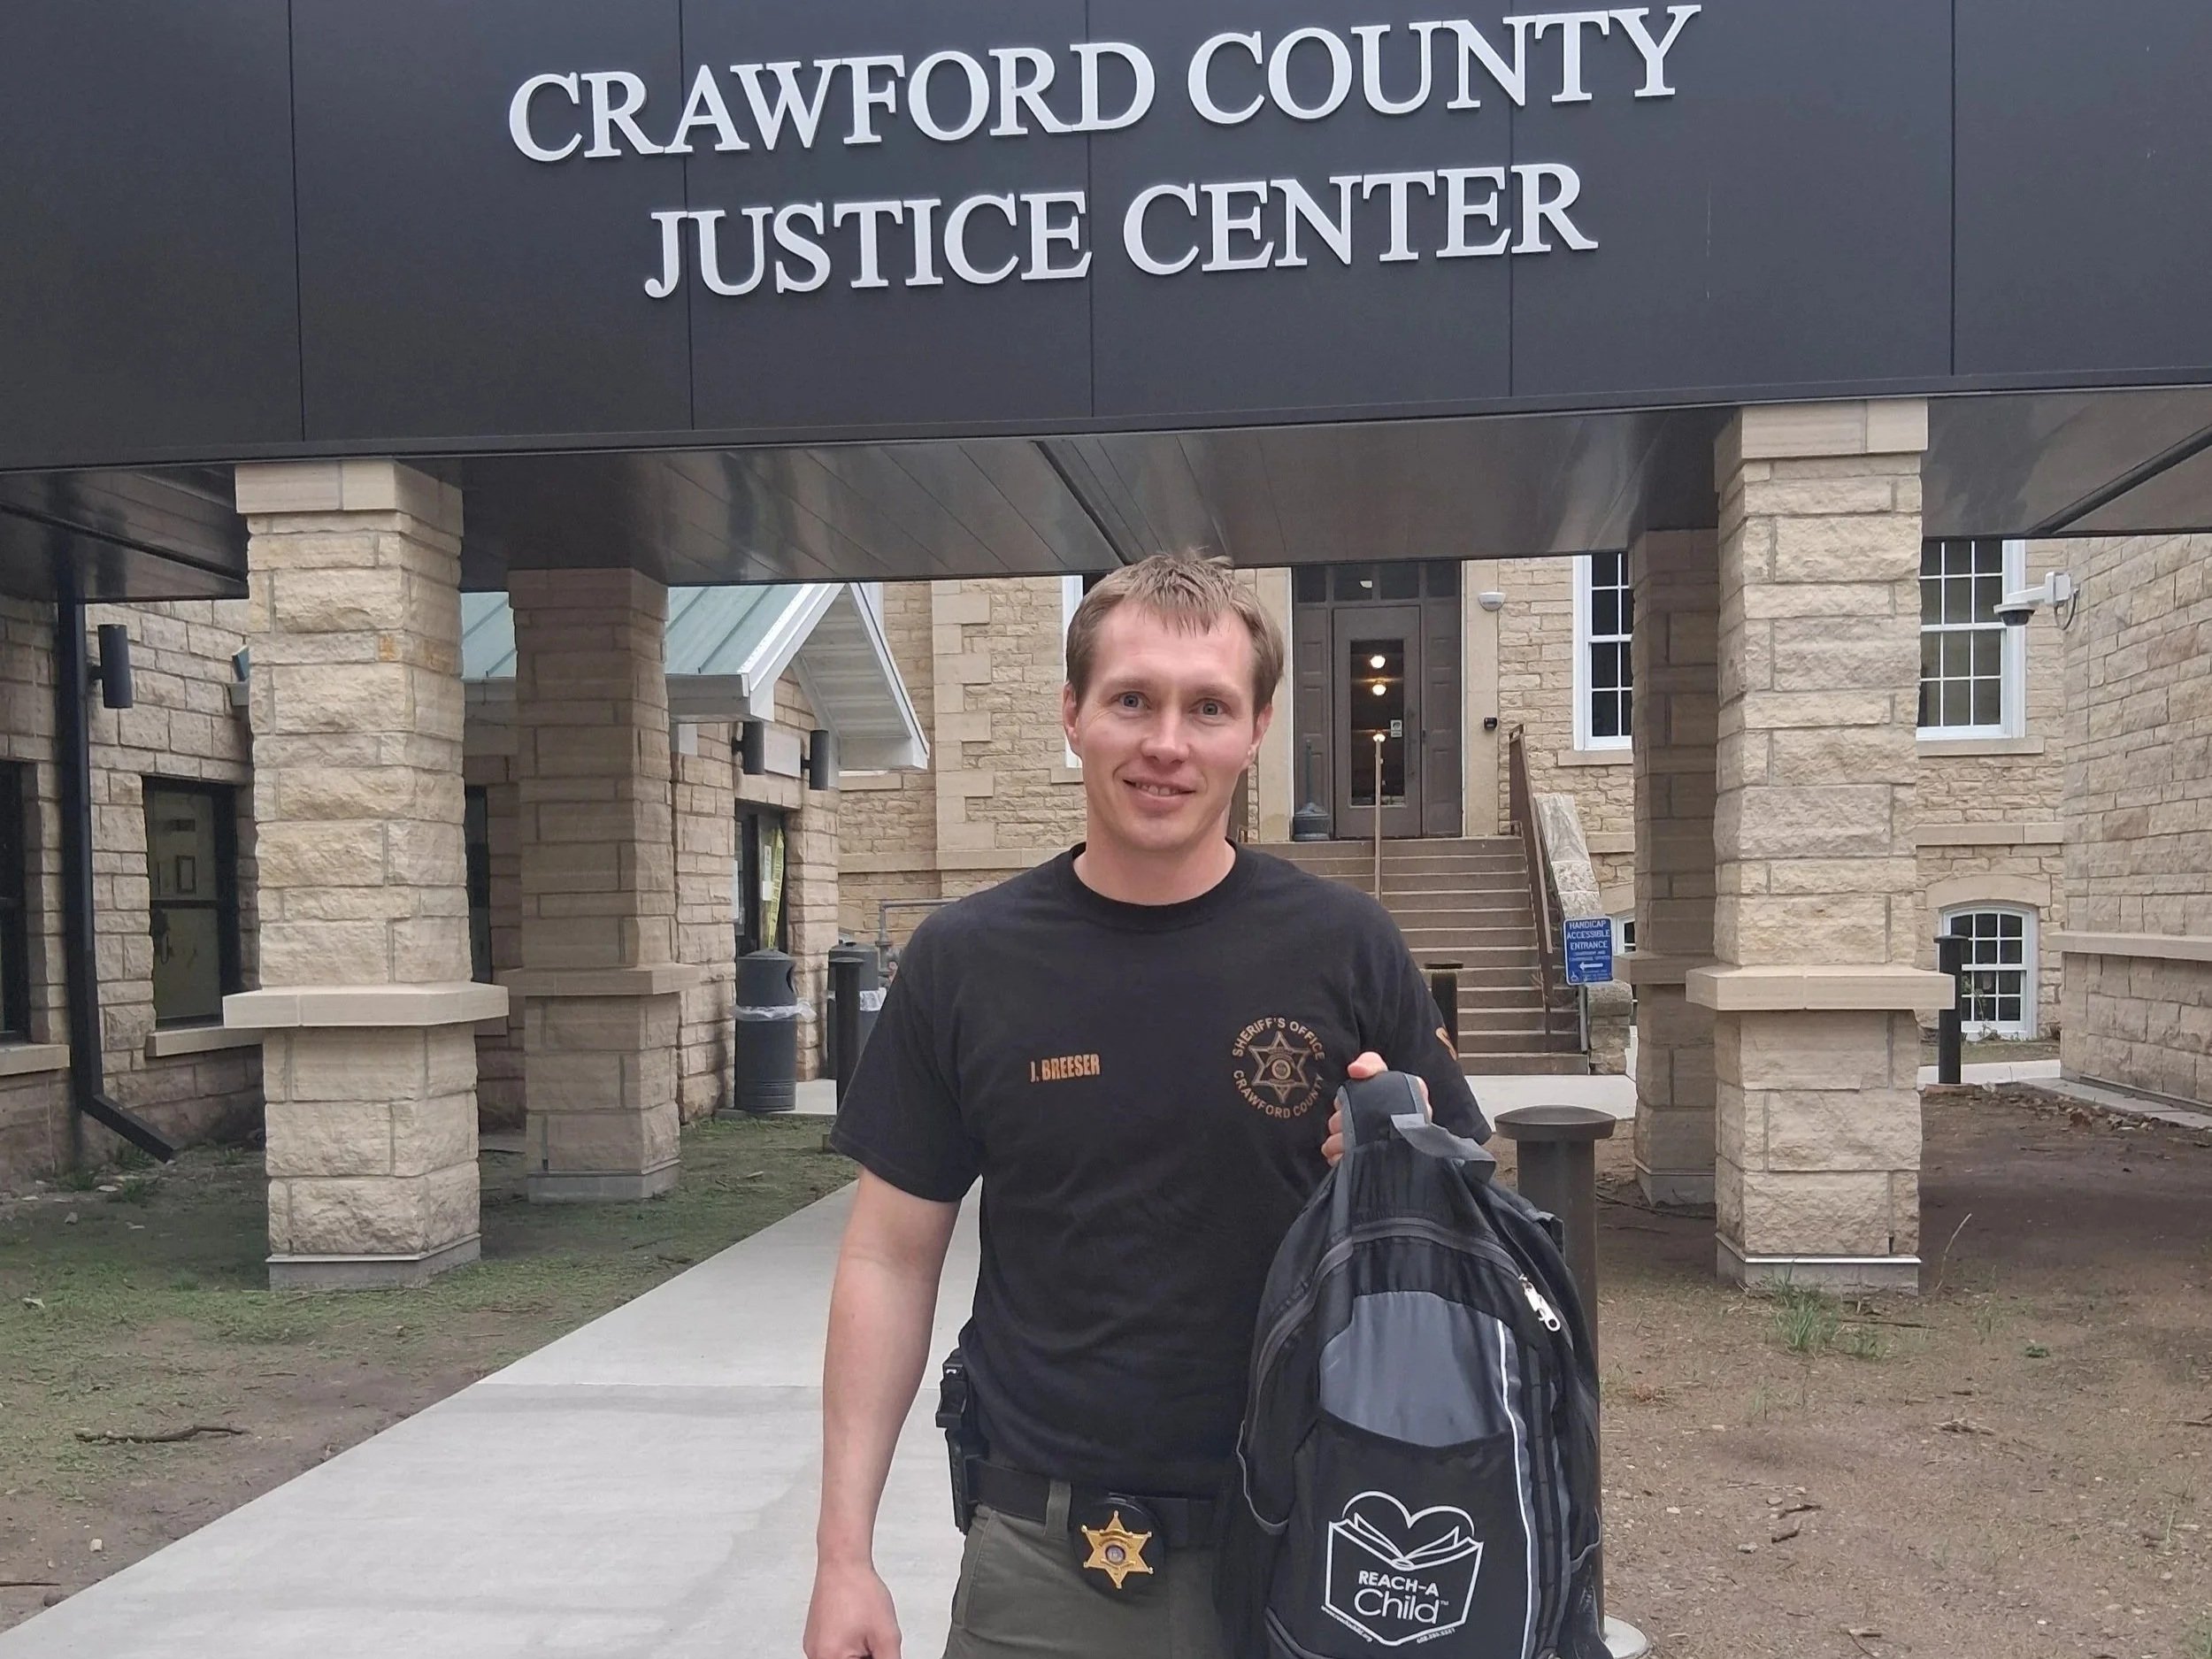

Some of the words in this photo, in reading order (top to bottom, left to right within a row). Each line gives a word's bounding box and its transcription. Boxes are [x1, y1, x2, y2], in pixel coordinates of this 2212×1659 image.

[509, 42, 1156, 162] CRAWFORD
[1187, 4, 1702, 125] COUNTY
[644, 190, 1093, 299] JUSTICE
[1123, 163, 1599, 275] CENTER
[1567, 929, 1610, 940] ACCESSIBLE
[1569, 920, 1607, 929] HANDICAP
[1570, 941, 1609, 950] ENTRANCE
[1232, 1017, 1286, 1057] SHERIFF'S
[1289, 1020, 1325, 1061] OFFICE
[1041, 1054, 1101, 1081] BREESER
[1233, 1070, 1291, 1118] CRAWFORD
[1293, 1072, 1324, 1117] COUNTY
[1358, 1570, 1440, 1597] REACH-A
[1354, 1587, 1440, 1624] Child
